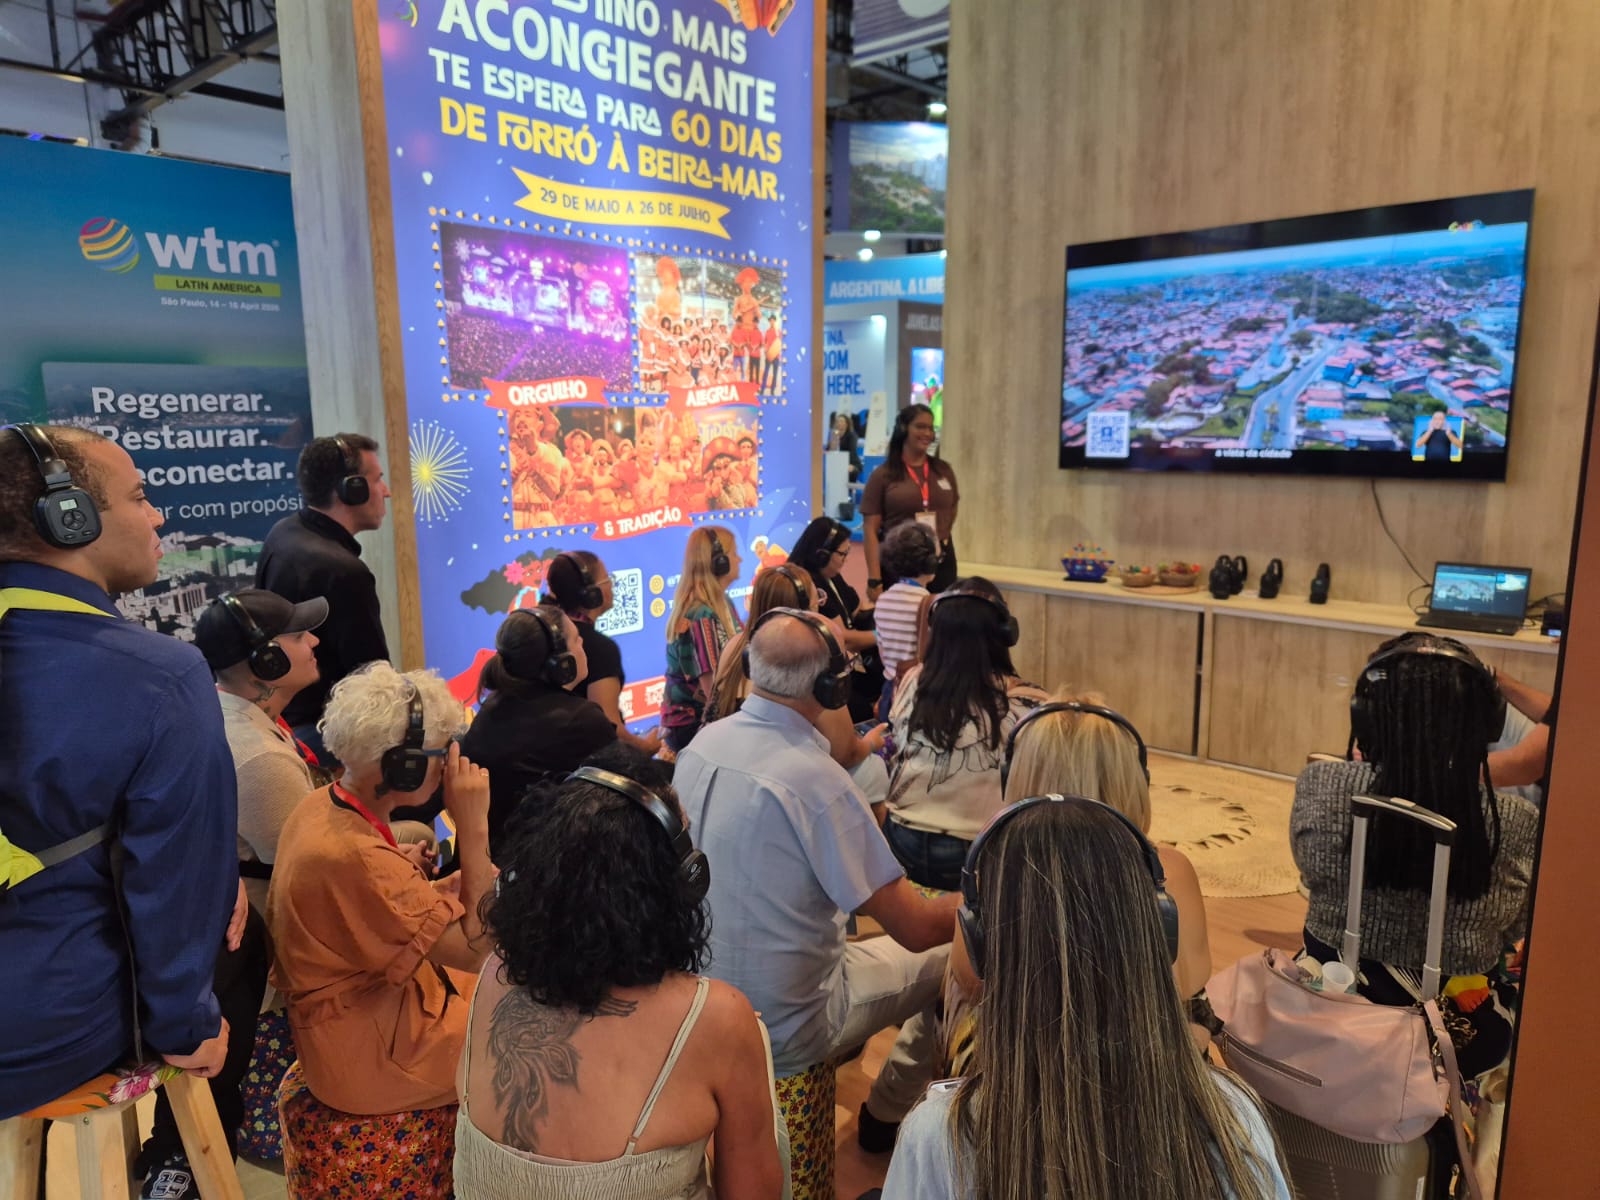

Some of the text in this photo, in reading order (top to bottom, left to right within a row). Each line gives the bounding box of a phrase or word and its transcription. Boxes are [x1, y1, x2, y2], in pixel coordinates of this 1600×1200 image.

[672, 9, 748, 65] MAIS
[437, 0, 777, 124] ACONCHEGANTE
[428, 47, 782, 164] TE ESPERA PARA 60 DIAS
[439, 96, 778, 202] DE FORRÓ À BEIRA-MAR
[540, 187, 711, 224] 29 DE MAIO A 26 DE JULHO
[144, 226, 277, 276] wtm
[175, 279, 262, 294] LATIN AMERICA
[829, 278, 905, 298] ARGENTINA.
[908, 277, 917, 295] A
[508, 380, 588, 406] ORGULHO
[686, 384, 740, 407] ALEGRIA
[827, 374, 864, 395] HERE.
[92, 387, 272, 419] Regenerar.
[179, 503, 225, 519] com
[616, 505, 681, 533] TRADIÇÃO
